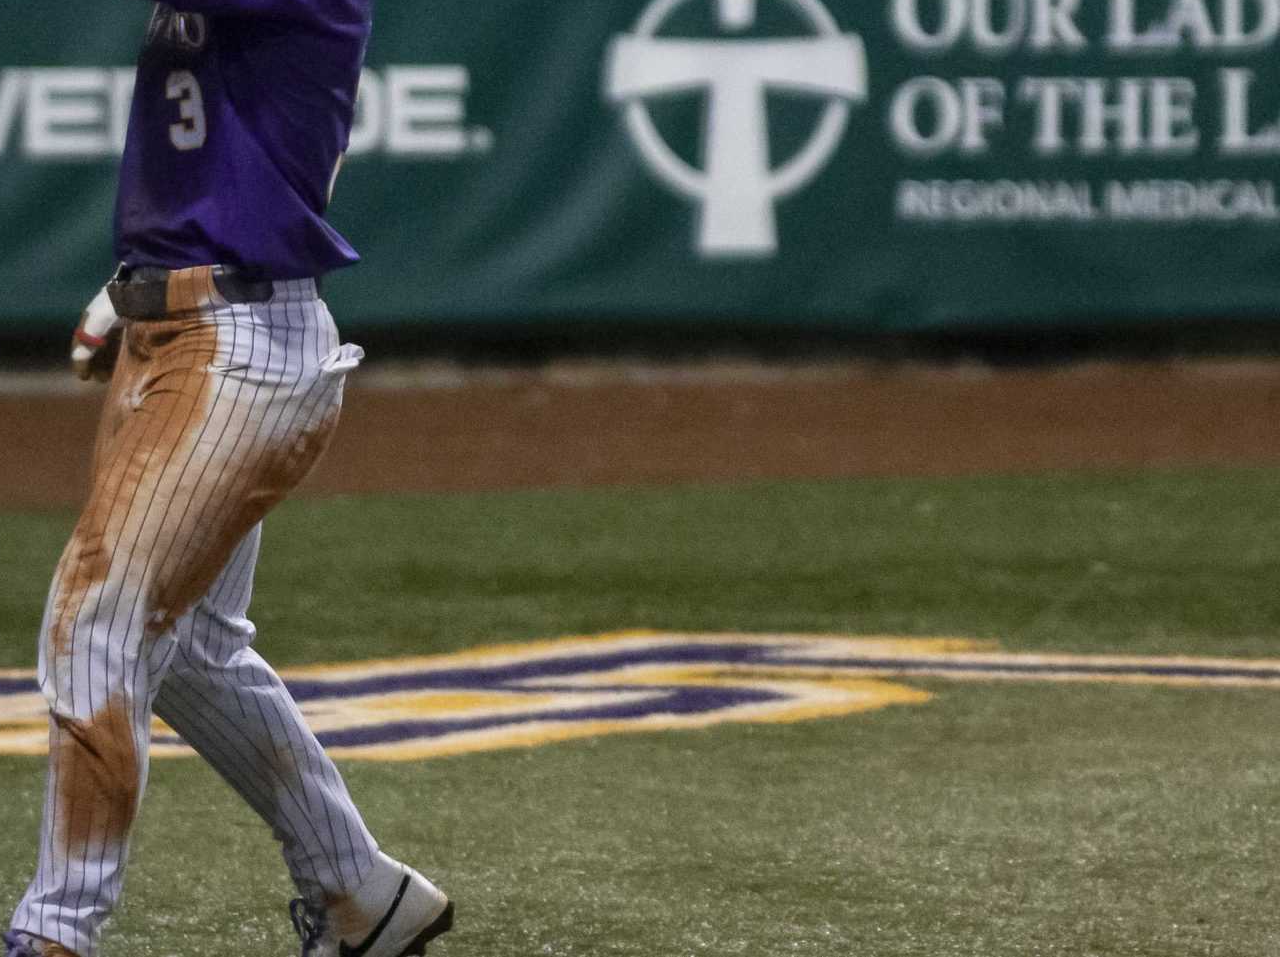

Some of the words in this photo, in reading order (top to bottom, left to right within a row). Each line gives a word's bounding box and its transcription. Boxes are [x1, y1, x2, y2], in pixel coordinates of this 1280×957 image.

[165, 69, 207, 151] 3
[889, 75, 1006, 154] OF
[1018, 76, 1199, 154] THE
[896, 179, 1098, 220] REGIONAL
[1106, 179, 1280, 220] MEDICAL
